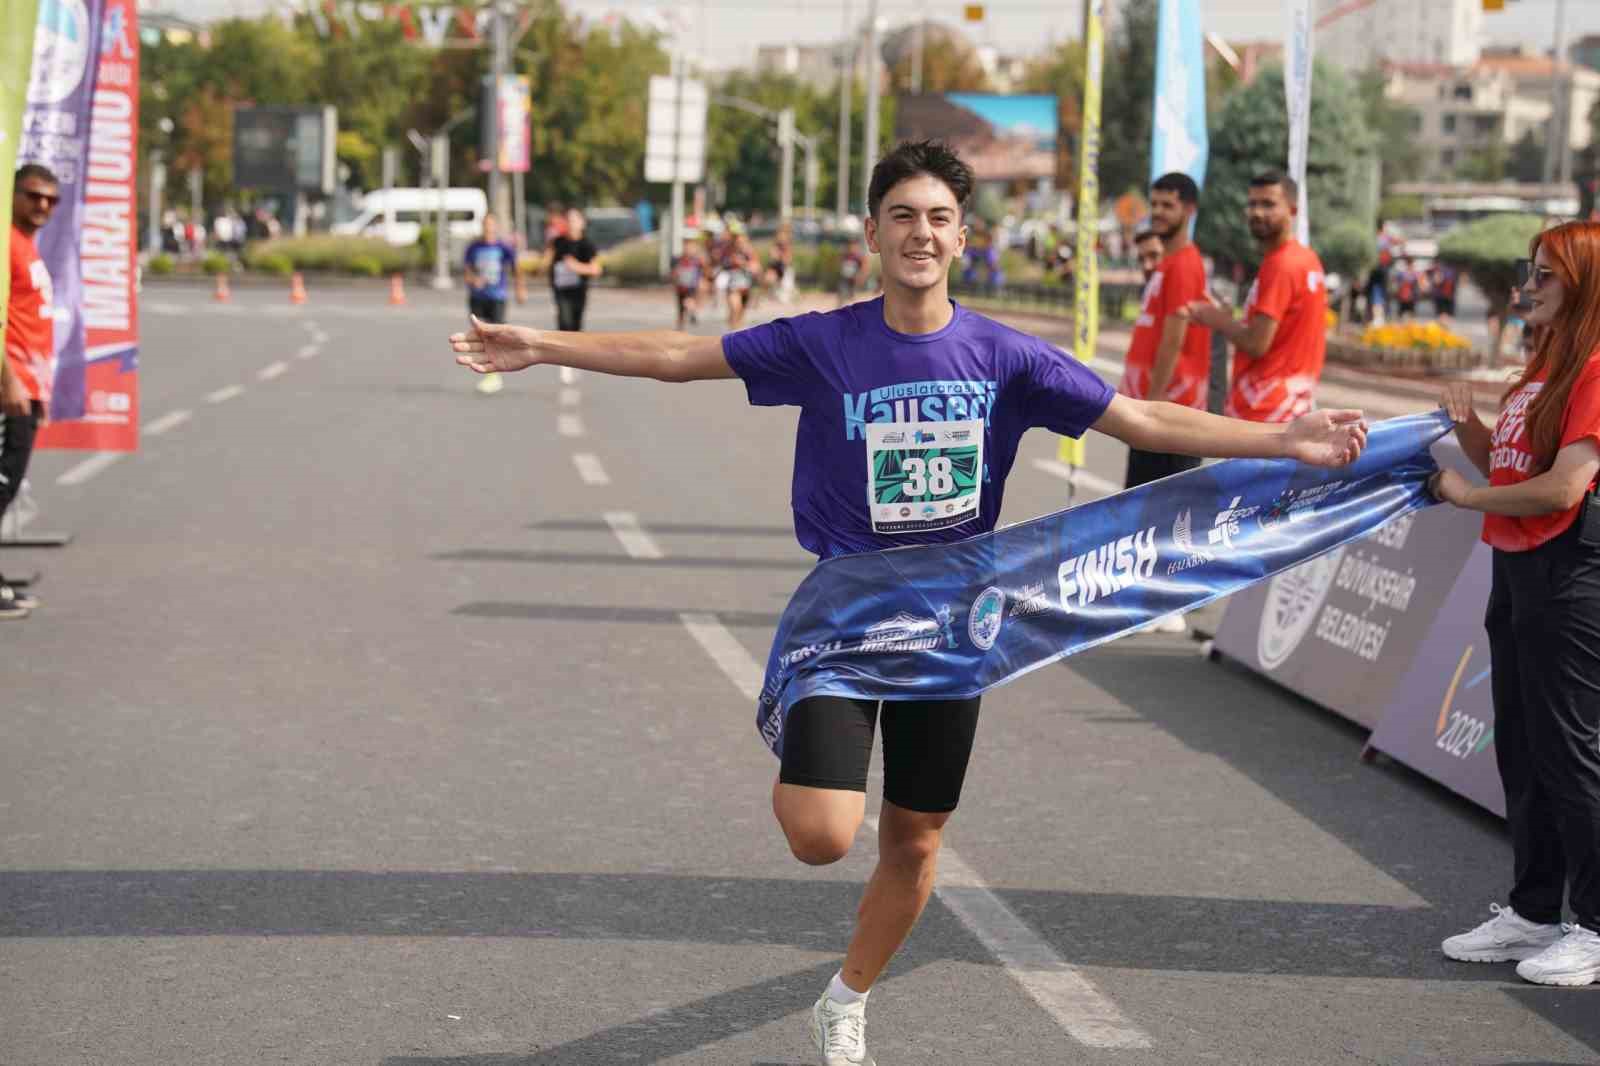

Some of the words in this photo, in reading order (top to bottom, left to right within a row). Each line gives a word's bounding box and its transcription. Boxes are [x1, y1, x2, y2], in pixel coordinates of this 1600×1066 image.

[902, 456, 953, 497] 38
[1058, 526, 1157, 614] FINISH
[1436, 709, 1486, 759] 2029
